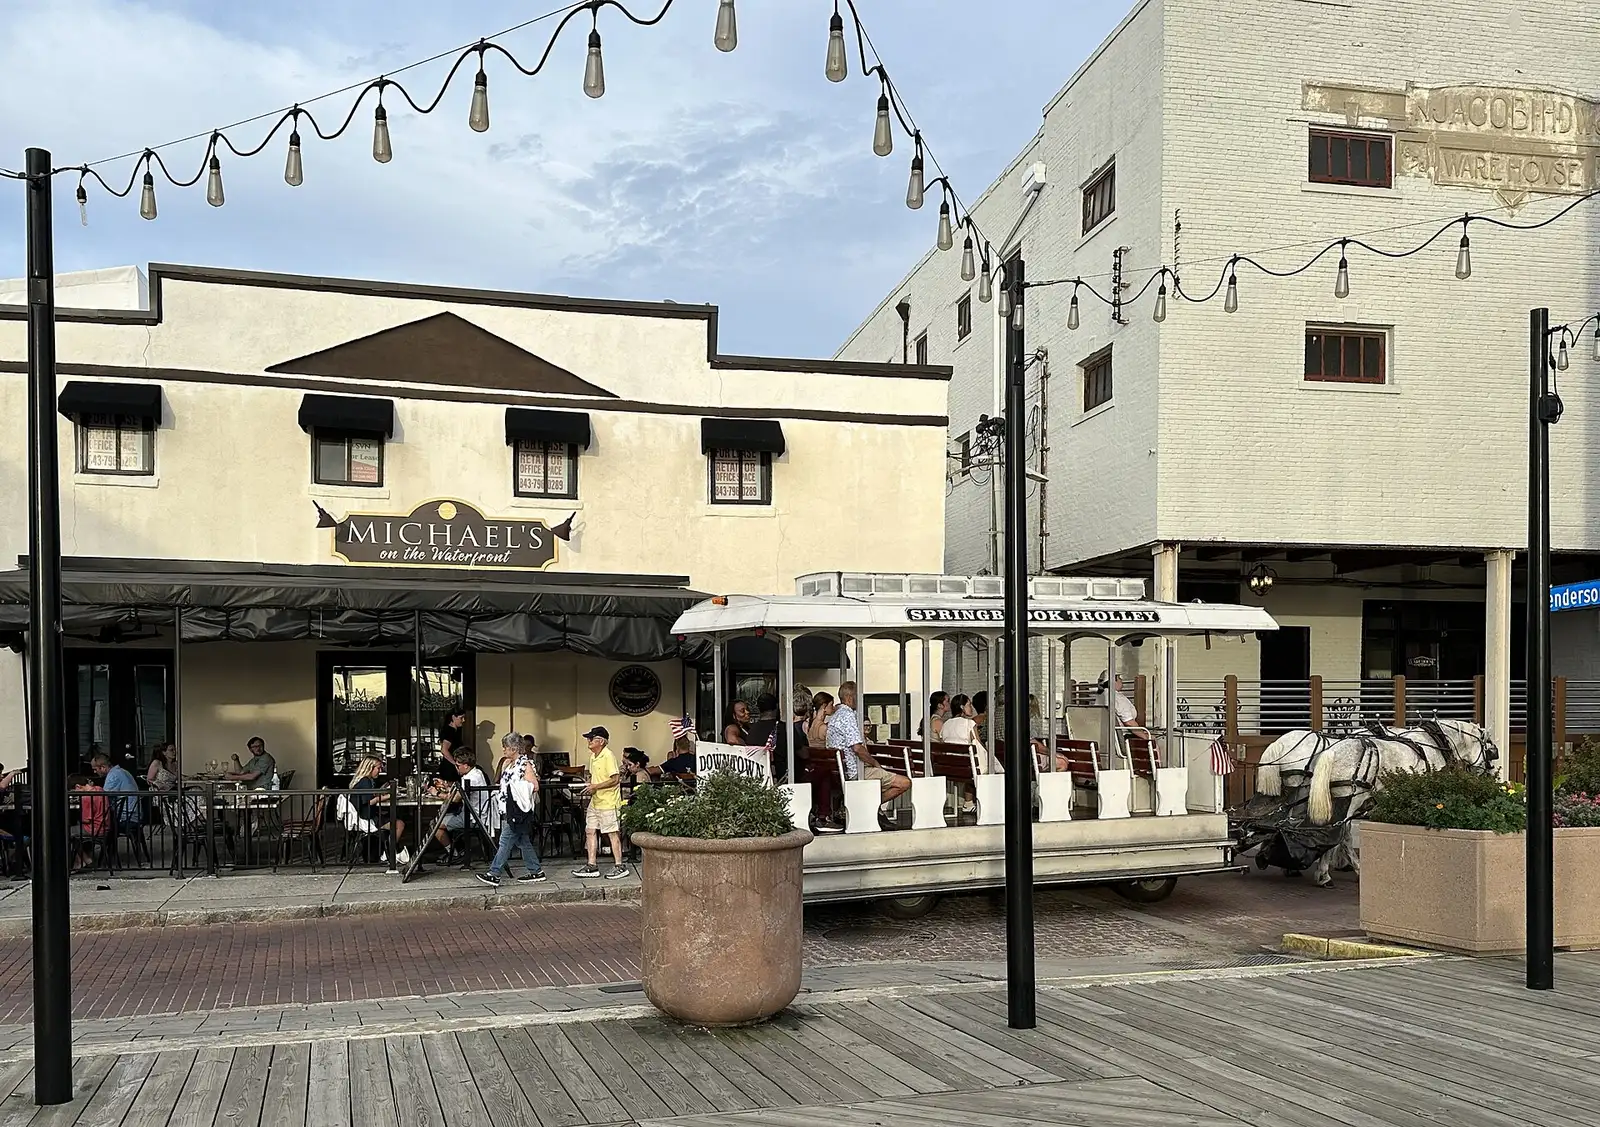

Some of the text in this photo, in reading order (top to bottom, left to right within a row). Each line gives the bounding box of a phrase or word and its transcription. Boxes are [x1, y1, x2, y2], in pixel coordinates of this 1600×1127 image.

[520, 453, 563, 466] RETAI OR
[520, 464, 543, 475] OFFICE
[715, 462, 756, 473] RETAI OR
[715, 472, 736, 482] OFFICE
[346, 520, 543, 550] MICHAEL'S
[380, 545, 512, 568] on the Waterfront
[910, 608, 1155, 621] SPRINGBOK TROLLEY
[632, 721, 639, 731] 5
[699, 753, 765, 779] DOWNTOWN
